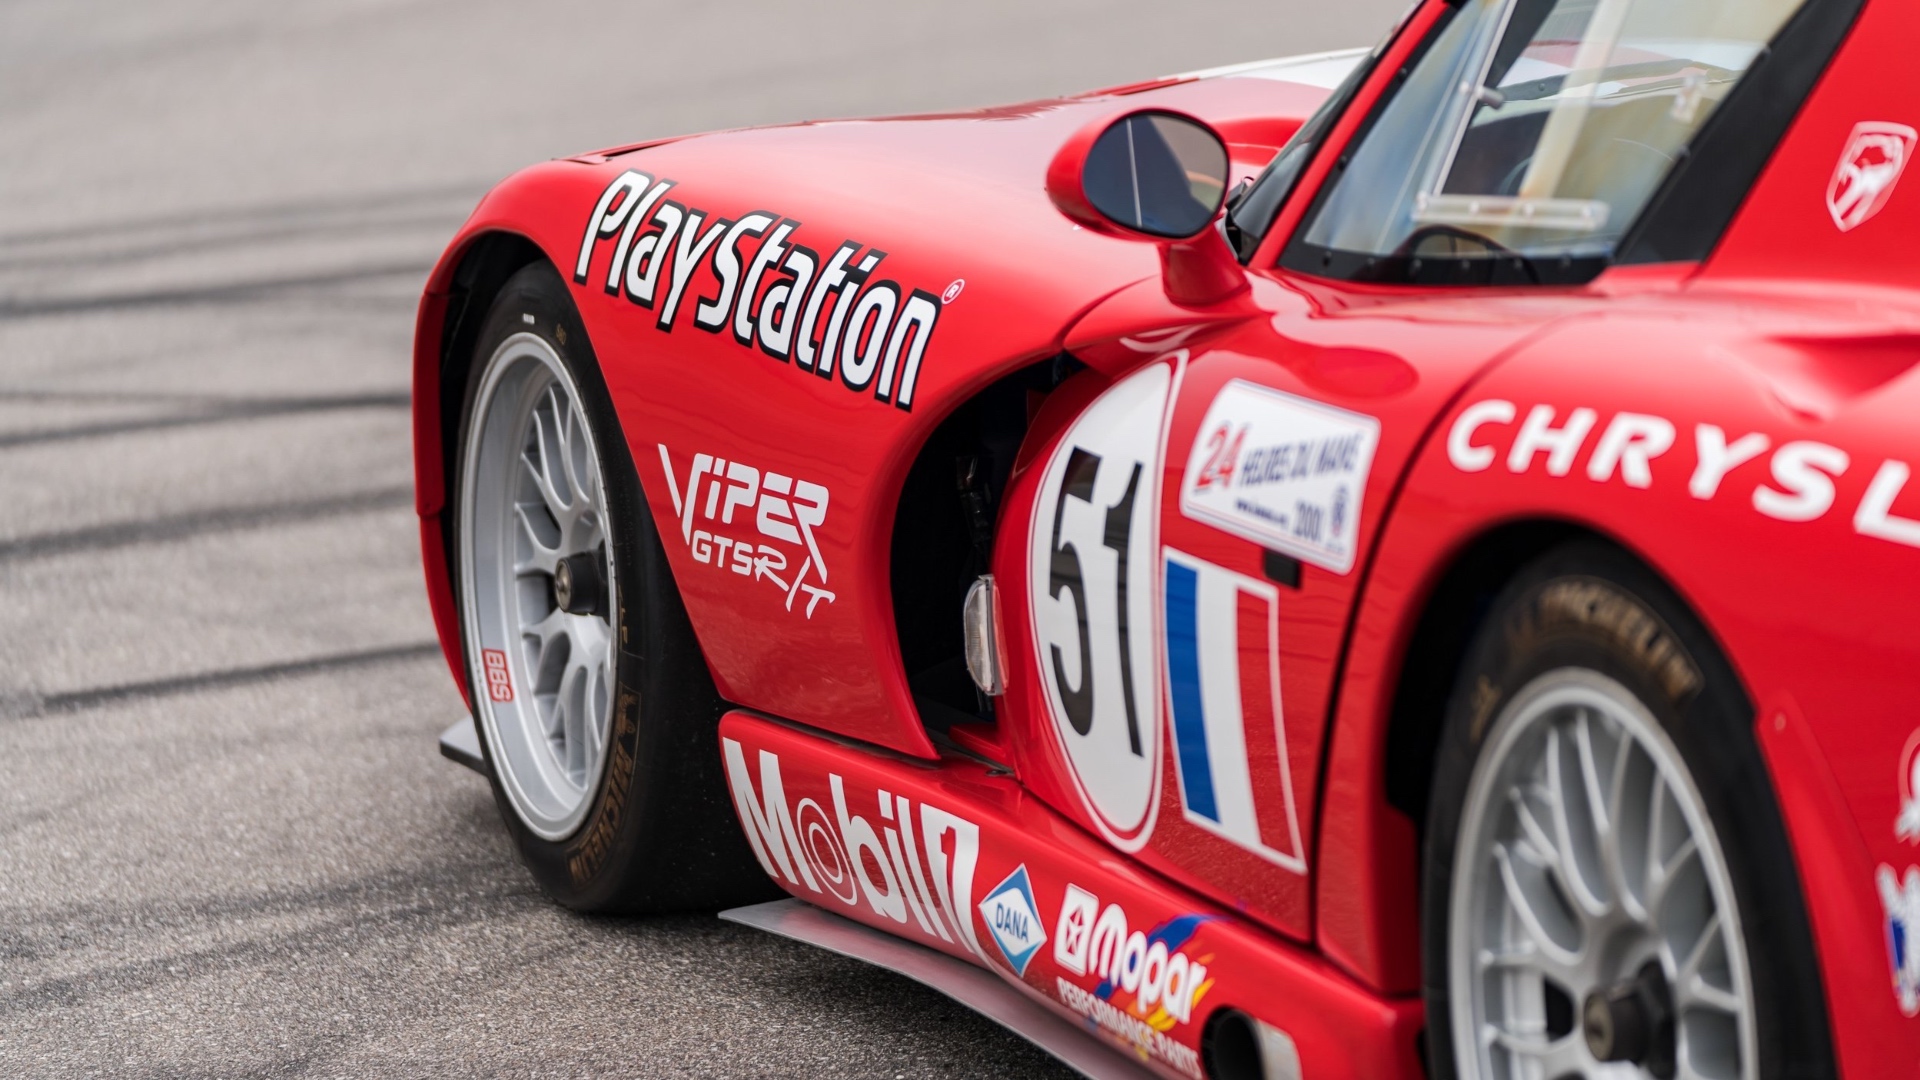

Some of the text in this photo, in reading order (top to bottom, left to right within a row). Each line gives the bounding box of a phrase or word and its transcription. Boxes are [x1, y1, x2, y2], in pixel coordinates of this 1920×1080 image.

[658, 443, 829, 584] VIPER
[1194, 420, 1250, 494] 24
[1049, 446, 1144, 759] 51
[484, 650, 513, 702] BBS
[568, 740, 633, 885] MICHELIN
[722, 737, 955, 944] Mobil
[995, 901, 1030, 944] DANA
[1057, 976, 1203, 1080] PERFORMANCE PARTS
